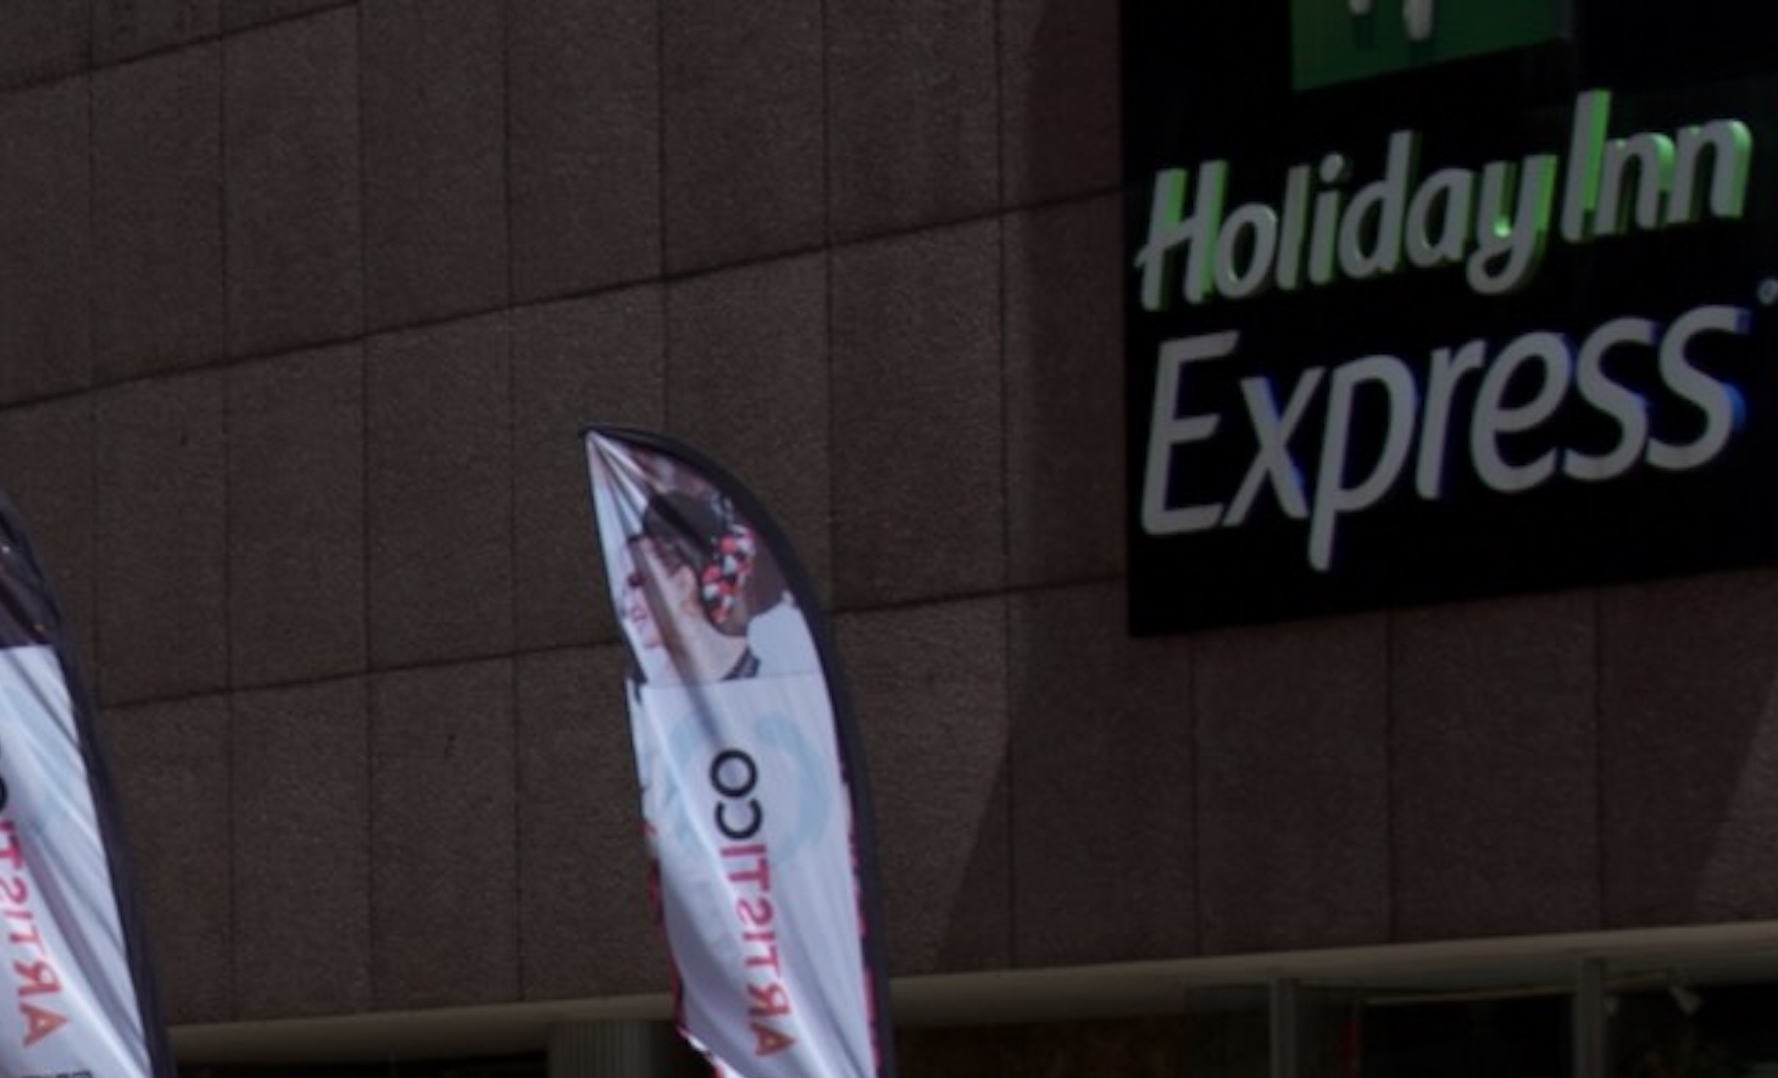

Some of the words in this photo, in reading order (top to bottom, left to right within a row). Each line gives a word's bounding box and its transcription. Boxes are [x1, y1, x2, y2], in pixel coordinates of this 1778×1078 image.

[1133, 129, 1558, 311] Holiday
[1561, 88, 1753, 244] Inn
[1140, 304, 1750, 573] Express
